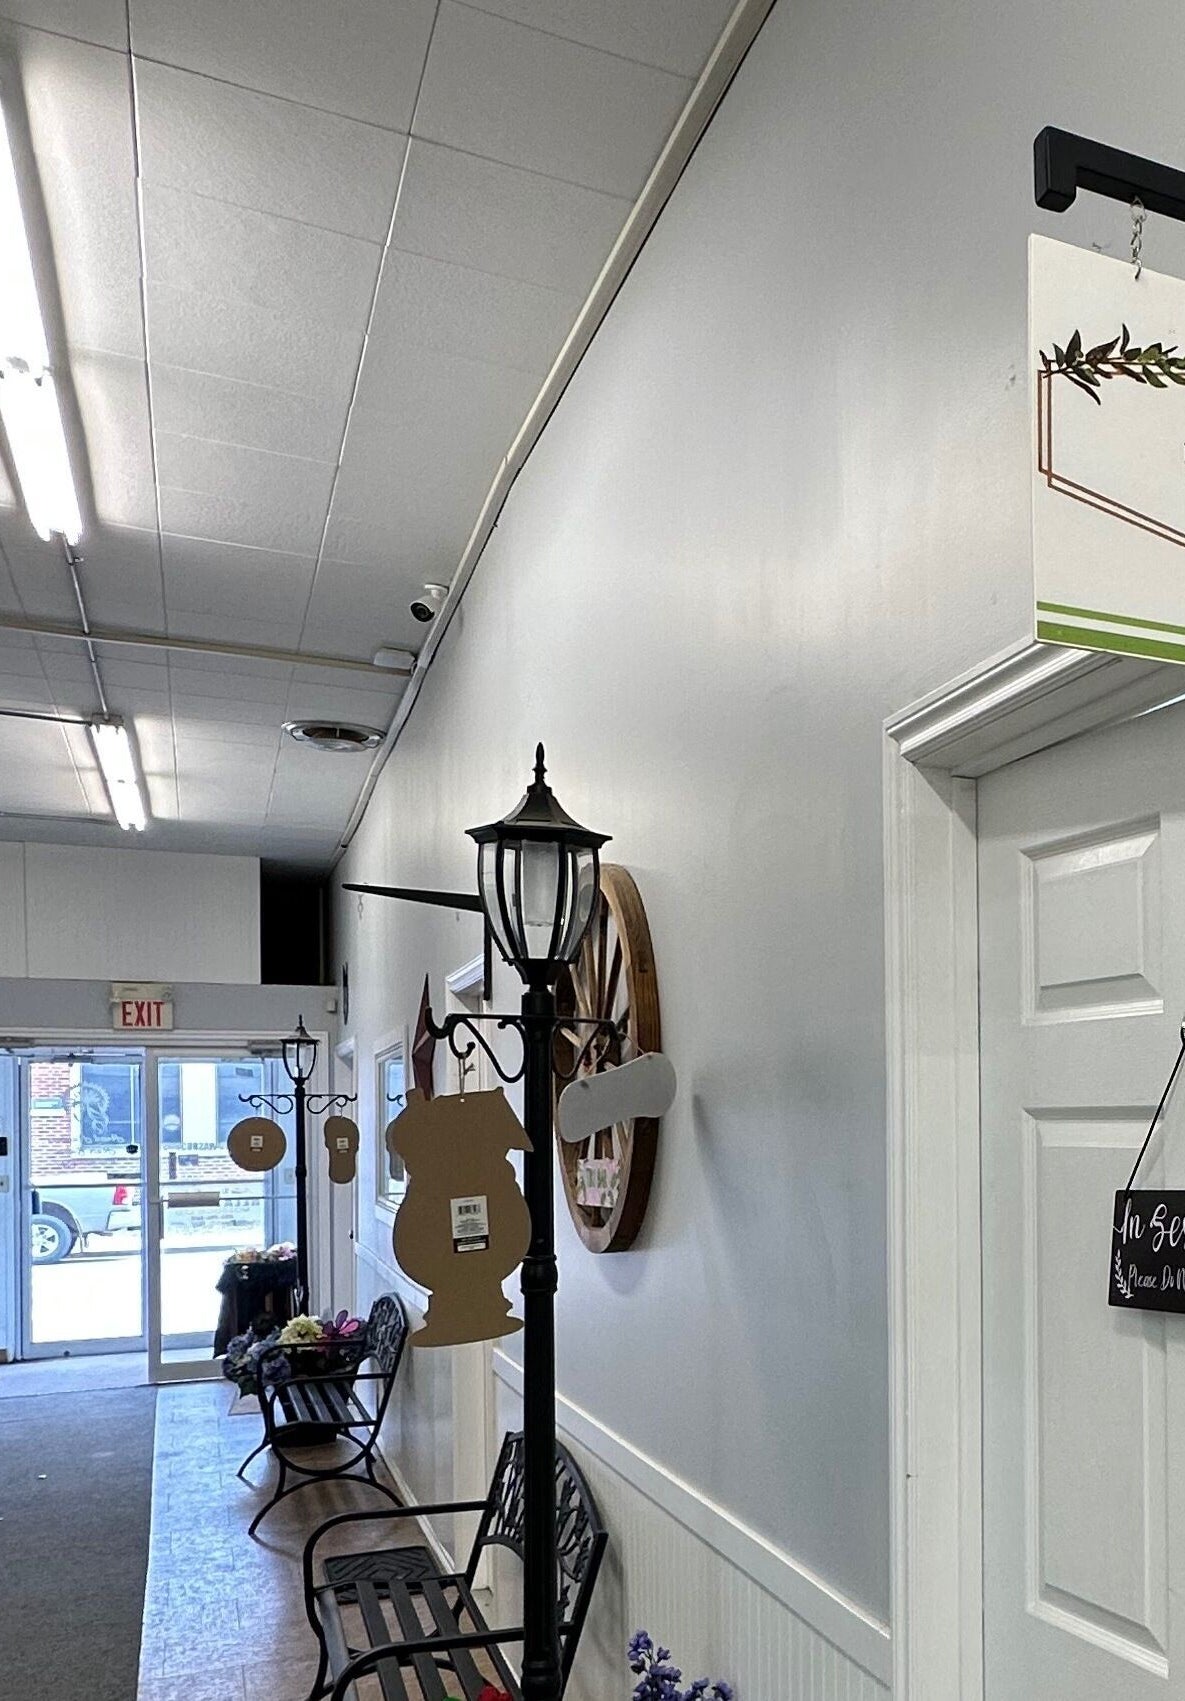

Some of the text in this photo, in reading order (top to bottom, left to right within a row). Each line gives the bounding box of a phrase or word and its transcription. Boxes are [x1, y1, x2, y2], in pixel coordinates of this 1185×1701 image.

[122, 1001, 165, 1027] EXIT
[1114, 1198, 1146, 1245] In
[1127, 1263, 1158, 1293] Please
[1160, 1264, 1174, 1291] Do
